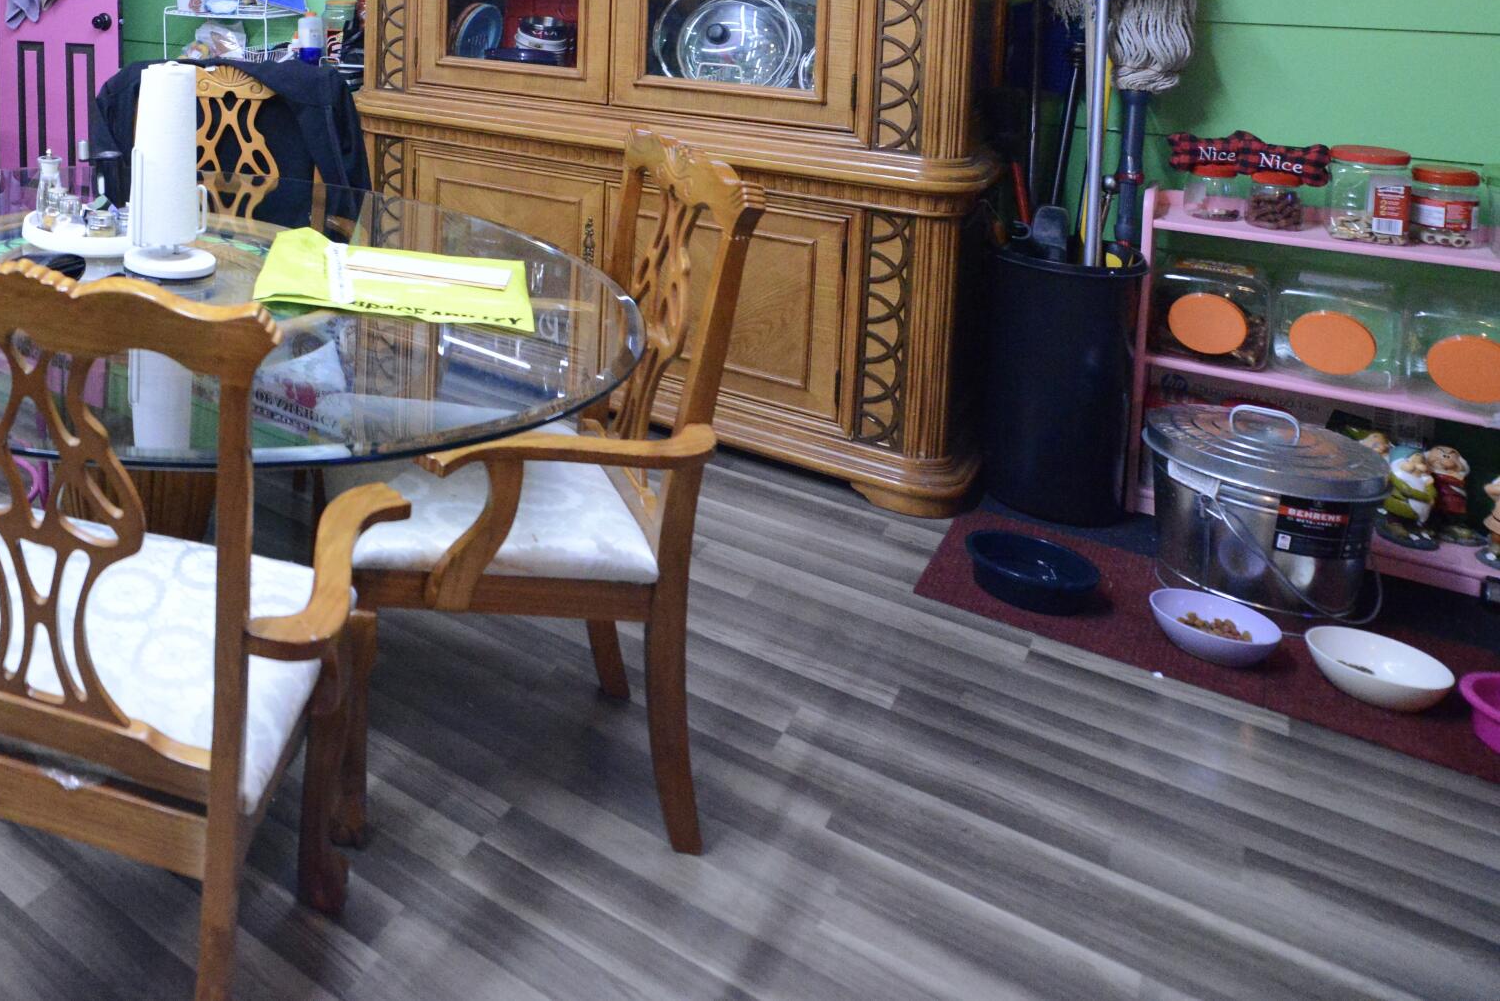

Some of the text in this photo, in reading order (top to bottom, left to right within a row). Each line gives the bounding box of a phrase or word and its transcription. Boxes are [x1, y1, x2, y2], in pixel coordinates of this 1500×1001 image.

[1198, 146, 1303, 174] Nice Nice
[1287, 507, 1342, 523] BEHRENS
